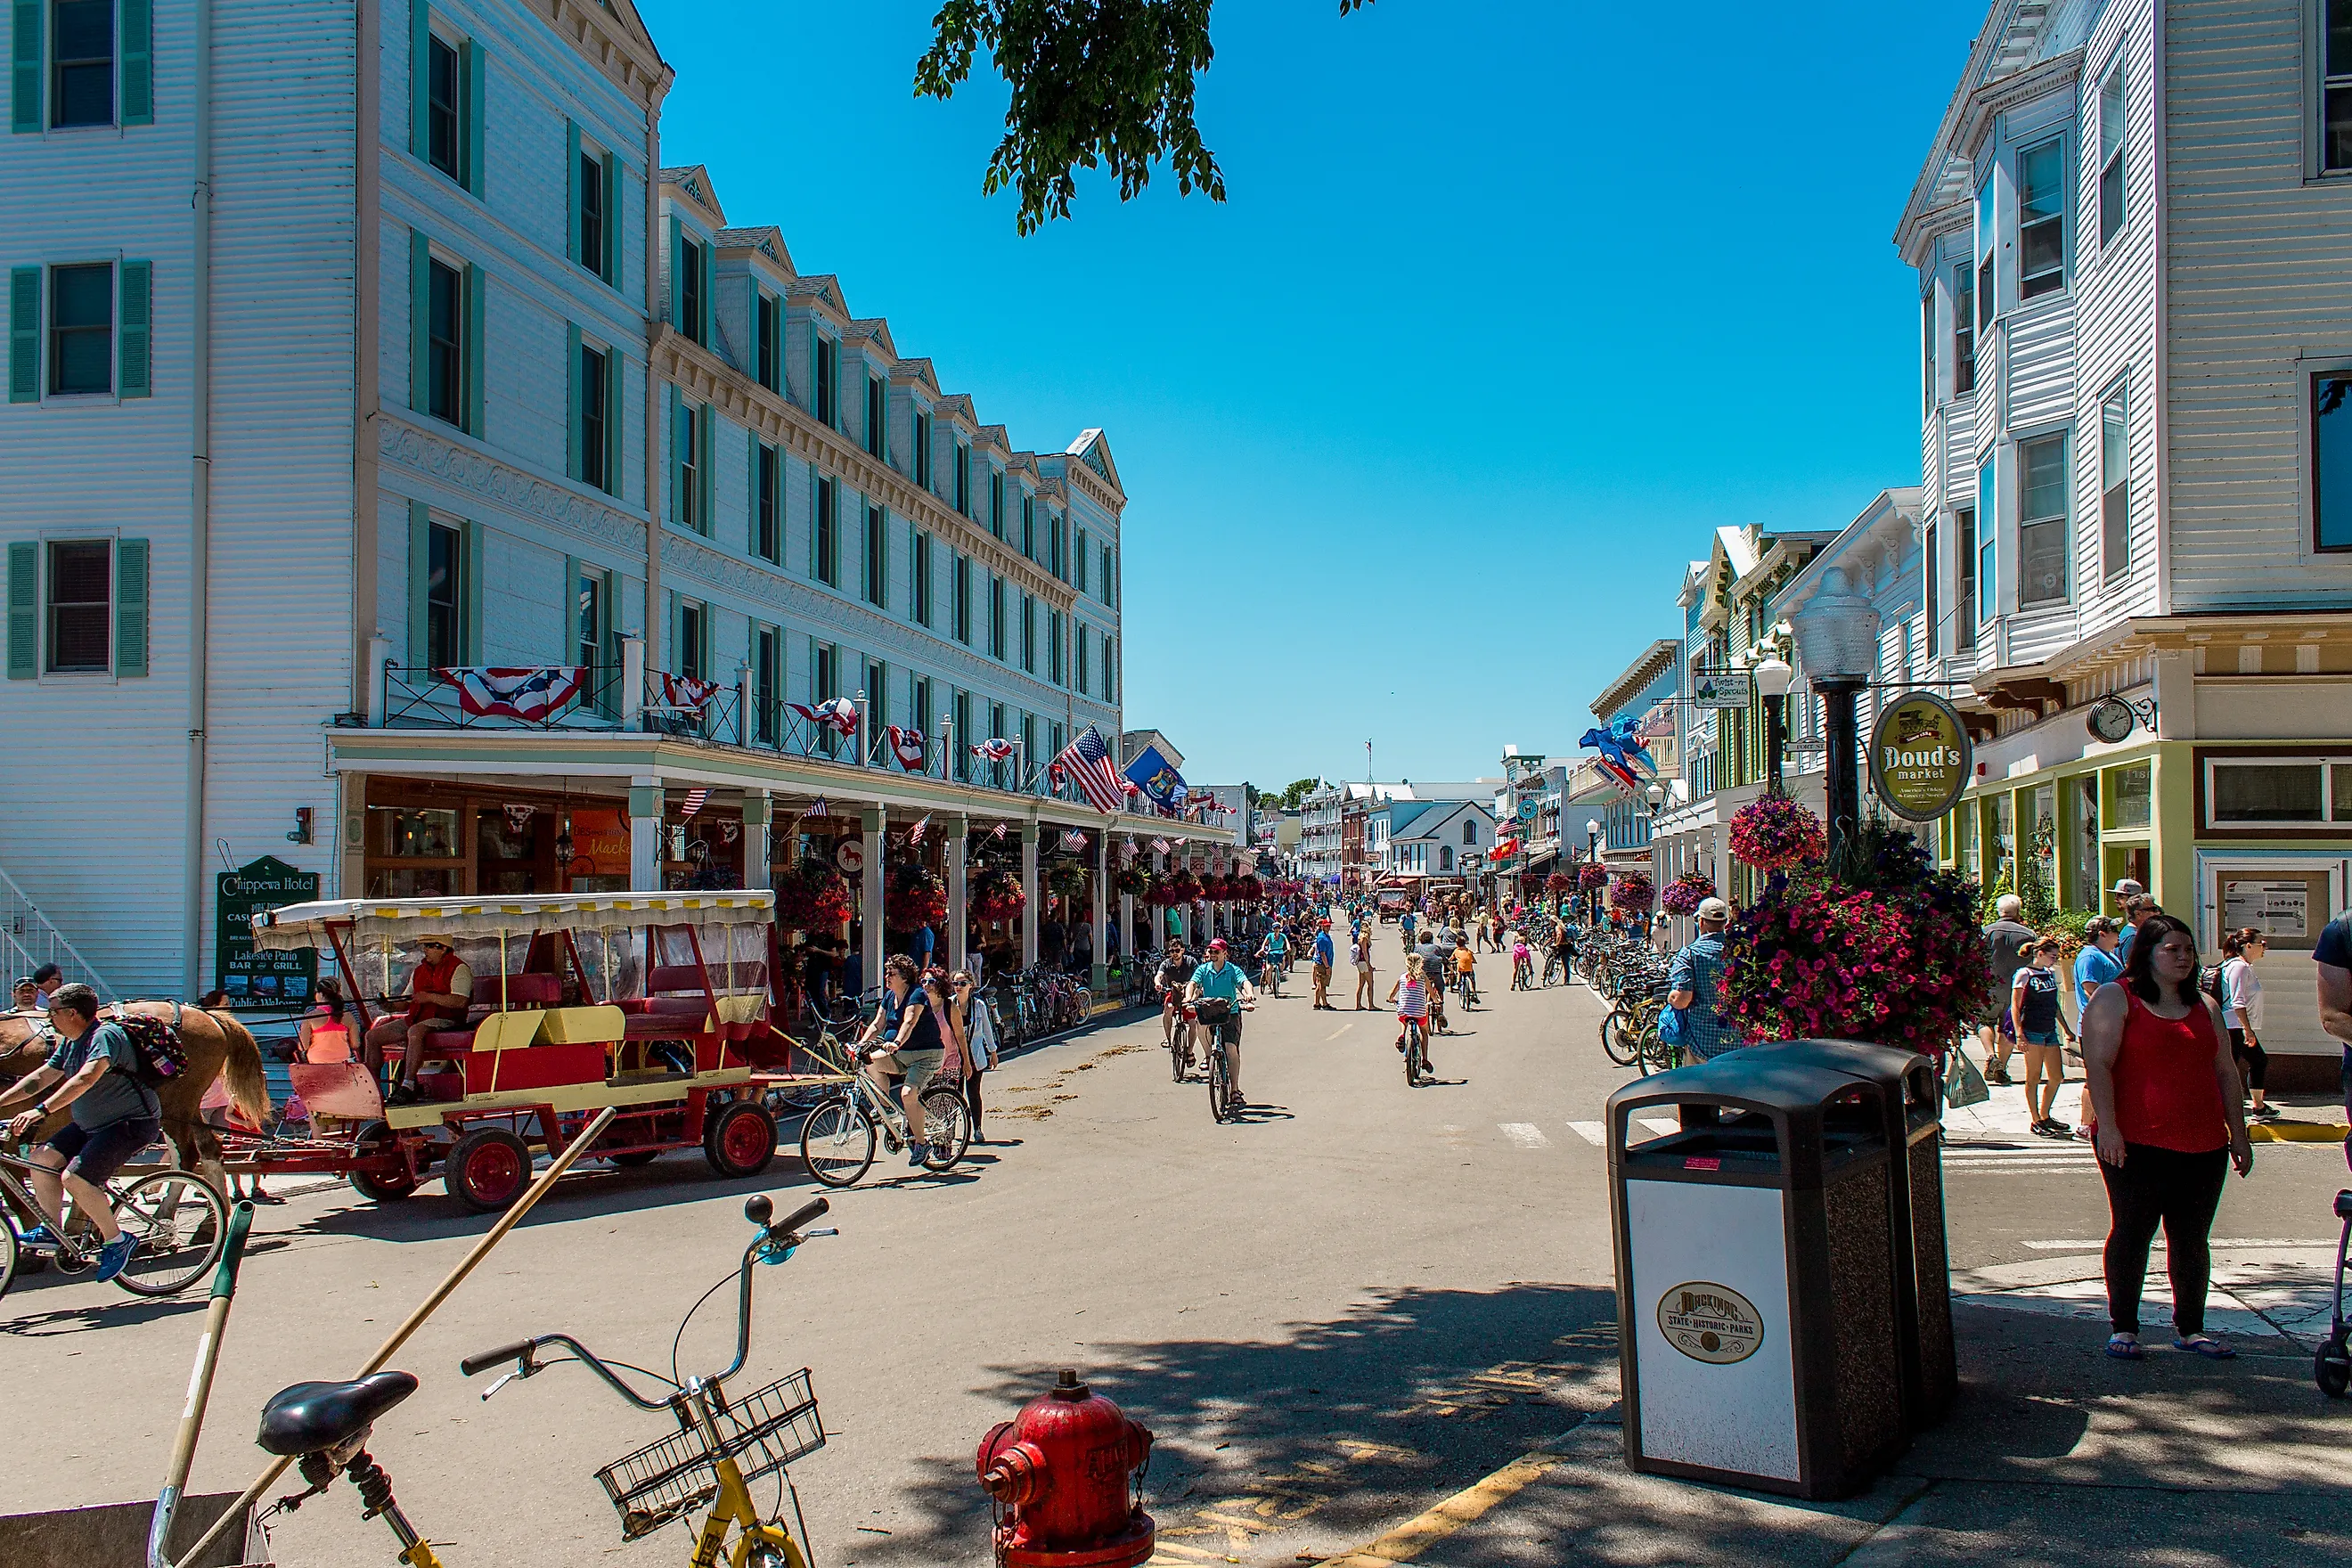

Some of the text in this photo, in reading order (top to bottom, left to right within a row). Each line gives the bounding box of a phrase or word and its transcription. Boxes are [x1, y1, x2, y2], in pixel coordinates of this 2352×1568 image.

[1712, 677, 1734, 687] Twist
[1719, 686, 1749, 697] Sprouts
[1882, 745, 1961, 773] Doud's
[1898, 768, 1945, 780] market
[222, 877, 314, 897] Chippewa Hotel
[234, 950, 298, 961] Lakeside Patio
[229, 961, 251, 969] BAR
[274, 962, 303, 970] GRILL
[230, 997, 257, 1008] Public
[1679, 1291, 1738, 1321] MACKINAC
[1729, 1324, 1754, 1335] PARKS
